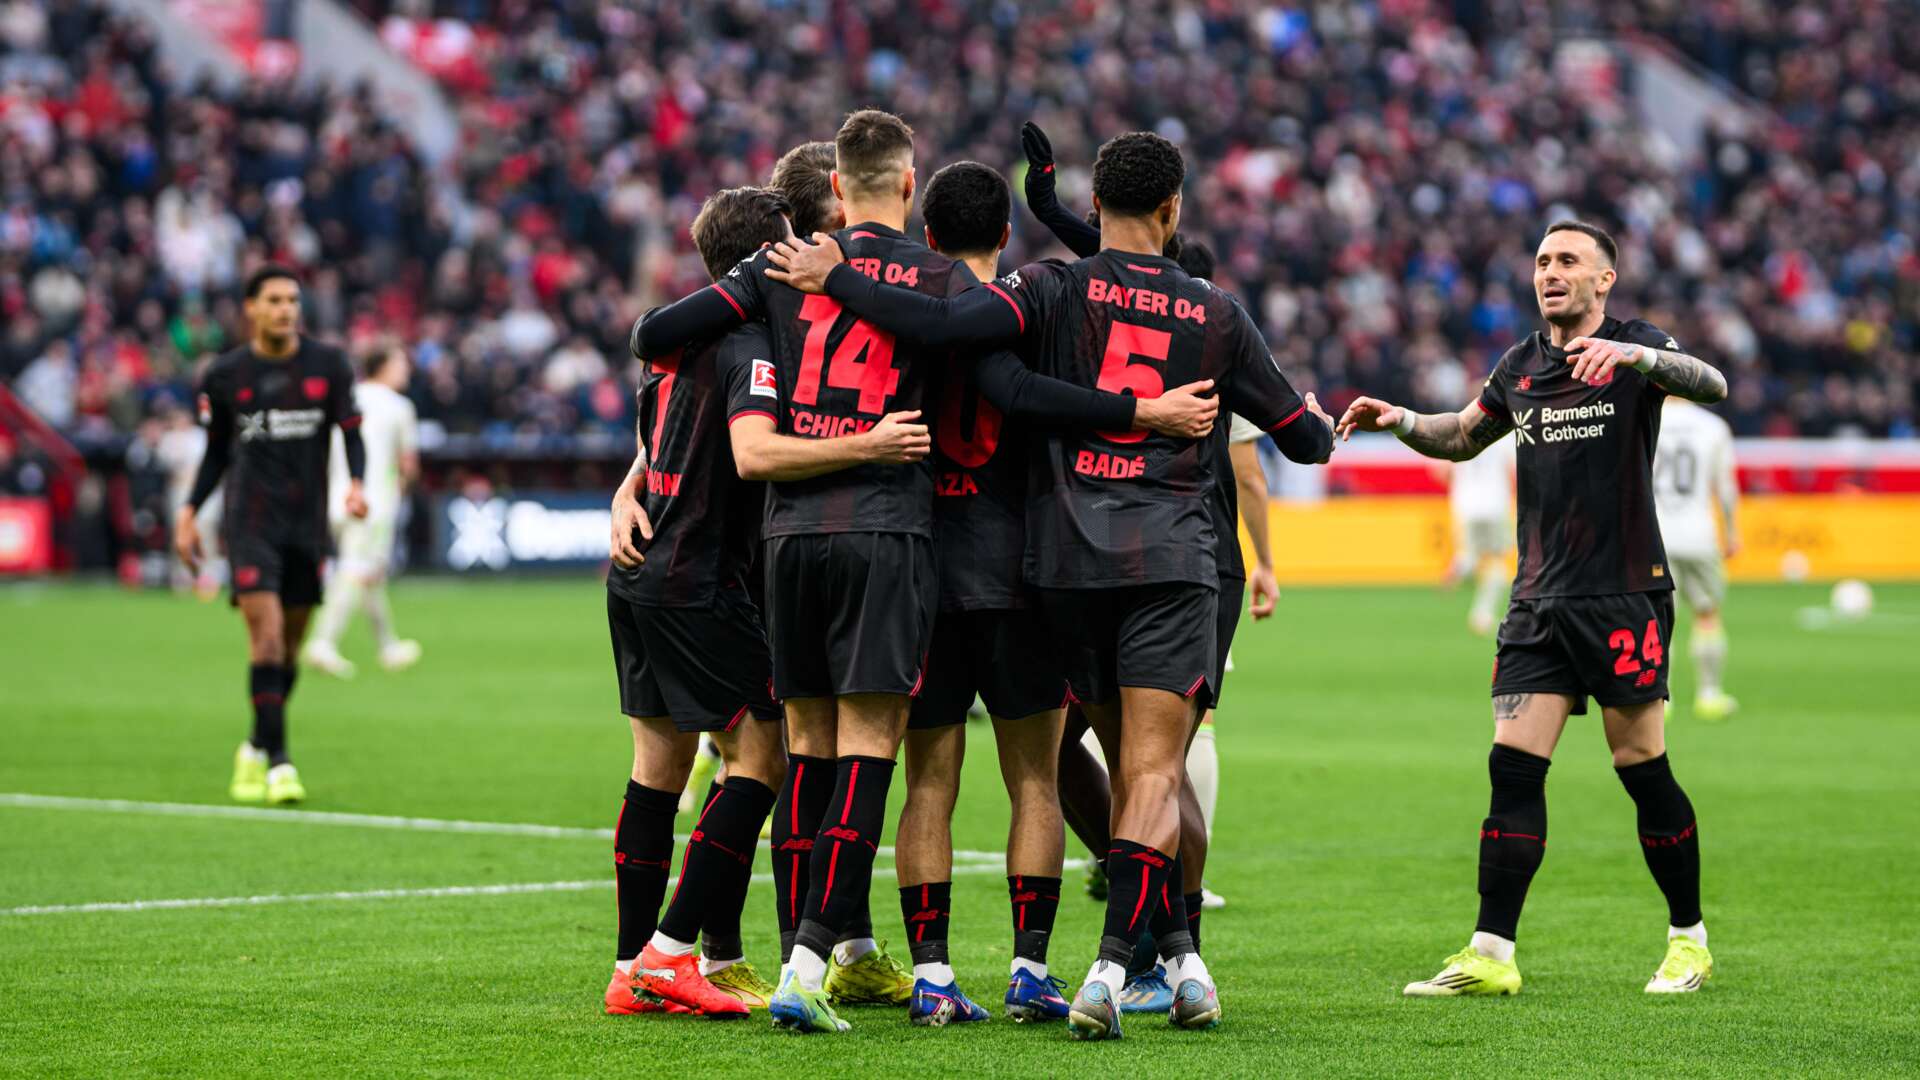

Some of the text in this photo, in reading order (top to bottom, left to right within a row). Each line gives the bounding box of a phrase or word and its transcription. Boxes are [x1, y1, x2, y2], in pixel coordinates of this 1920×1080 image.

[884, 262, 919, 288] 04
[1087, 278, 1206, 325] BAYER 04
[792, 292, 900, 416] 14
[1095, 320, 1172, 444] 5
[789, 407, 876, 438] CHICK
[1541, 400, 1616, 424] Barmenia
[1542, 423, 1606, 443] Gothaer
[1074, 450, 1147, 479] BADÉ
[1608, 619, 1663, 676] 24
